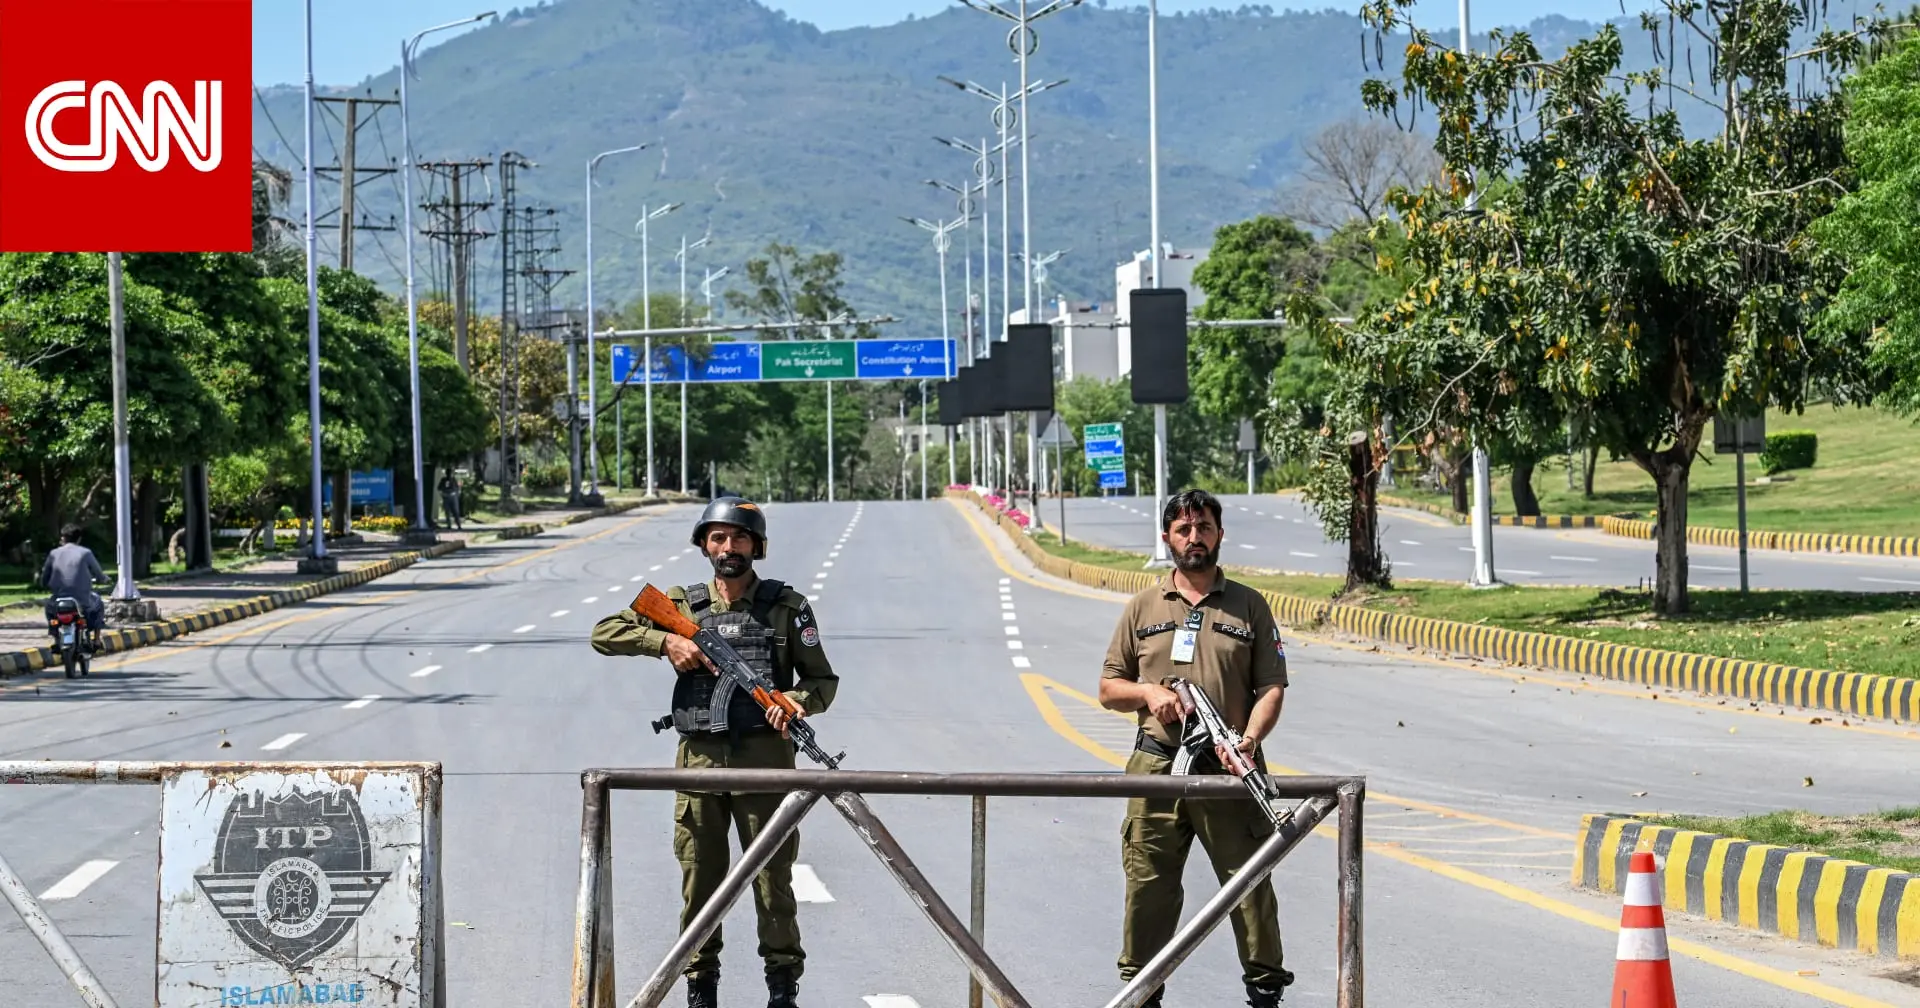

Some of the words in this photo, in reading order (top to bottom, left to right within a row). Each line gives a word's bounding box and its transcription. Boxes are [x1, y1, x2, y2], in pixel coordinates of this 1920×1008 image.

[775, 358, 792, 367] Pak
[794, 357, 844, 367] Secretariat
[861, 356, 917, 365] Constitution
[919, 356, 951, 364] Avenu
[707, 364, 742, 376] Airport
[1147, 623, 1166, 634] FIAZ
[1221, 624, 1248, 637] POLICE
[255, 827, 333, 849] ITP
[267, 860, 319, 878] ISLAMABAD
[220, 983, 364, 1006] ISLAMABAD
